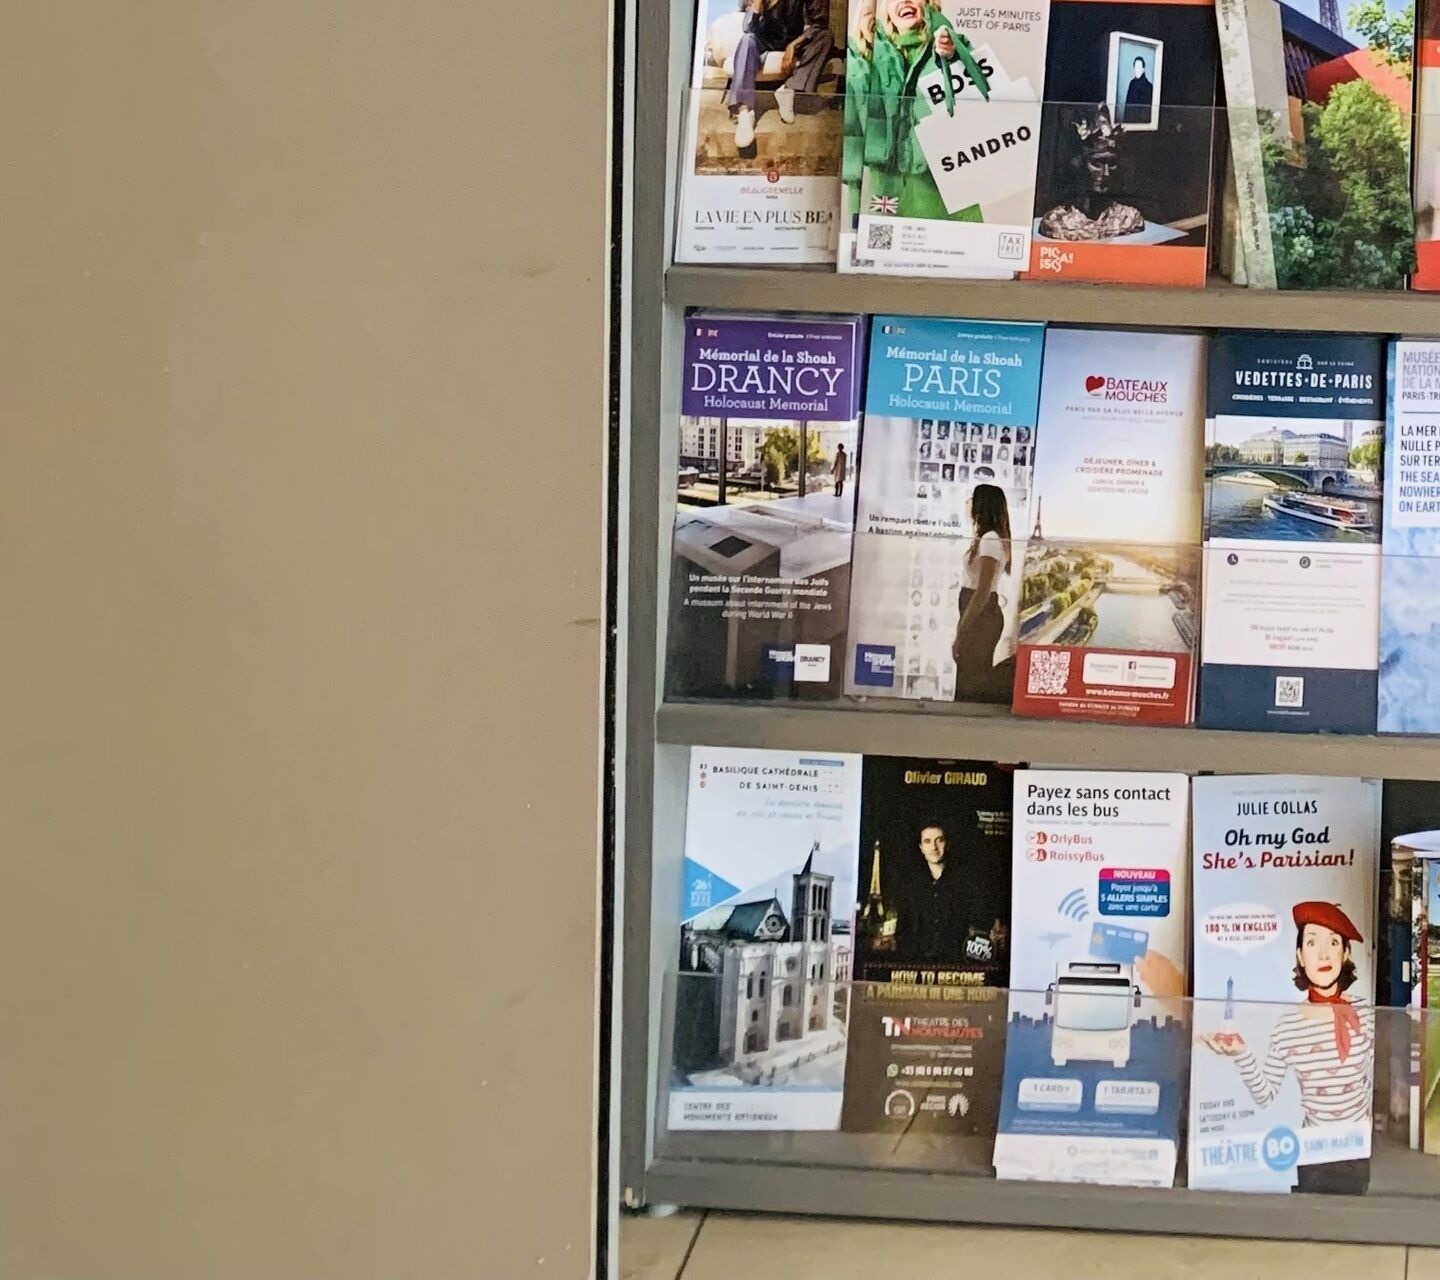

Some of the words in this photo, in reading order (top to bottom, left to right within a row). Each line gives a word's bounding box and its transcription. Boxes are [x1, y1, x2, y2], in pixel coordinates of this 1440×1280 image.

[956, 7, 981, 17] JUST
[983, 9, 997, 19] 45
[998, 10, 1042, 21] MINUTES
[954, 18, 983, 30] WEST
[986, 20, 999, 31] OF
[1002, 21, 1031, 33] PARIS
[941, 125, 1031, 172] SANDRO
[698, 348, 761, 362] Mémorial
[763, 351, 780, 363] de
[783, 351, 794, 363] la
[796, 351, 836, 365] Shoah
[886, 346, 947, 362] Mémorial
[950, 349, 966, 363] de
[968, 349, 980, 364] la
[982, 351, 1023, 367] Shoah
[1402, 349, 1440, 364] MUSÉE
[691, 363, 844, 397] DRANCY
[902, 363, 1002, 398] PARIS
[1106, 377, 1168, 393] BATEAUX
[1402, 376, 1417, 389] DE
[1418, 377, 1432, 389] LA
[703, 395, 767, 410] Holocaust
[768, 398, 829, 412] Memorial
[1104, 391, 1167, 404] MOUCHES
[1400, 425, 1415, 437] LA
[1416, 426, 1437, 438] MER
[1400, 439, 1432, 452] NULLE
[1400, 454, 1421, 467] SUR
[1400, 470, 1418, 483] THE
[1420, 471, 1440, 483] SEA
[1399, 501, 1414, 513] ON
[712, 765, 759, 775] BASILIQUE
[762, 766, 819, 778] CATHÉDRALE
[904, 770, 942, 785] Olivier
[944, 771, 988, 786] GIRAUD
[1027, 784, 1072, 802] Payez
[1075, 787, 1110, 800] sans
[1113, 787, 1172, 801] contact
[1026, 801, 1063, 816] dans
[1067, 802, 1088, 817] les
[1093, 802, 1120, 818] bus
[1236, 801, 1269, 816] JULIE
[1273, 800, 1318, 814] COLLAS
[1049, 833, 1093, 846] OrlyBus
[1224, 828, 1252, 847] Oh
[1255, 832, 1288, 849] my
[1291, 826, 1332, 845] God
[1049, 850, 1105, 863] RoissyBus
[1202, 851, 1257, 870] She's
[1260, 848, 1355, 868] Parisian!
[1113, 869, 1157, 879] NOUVEAU
[1266, 1135, 1295, 1160] BO
